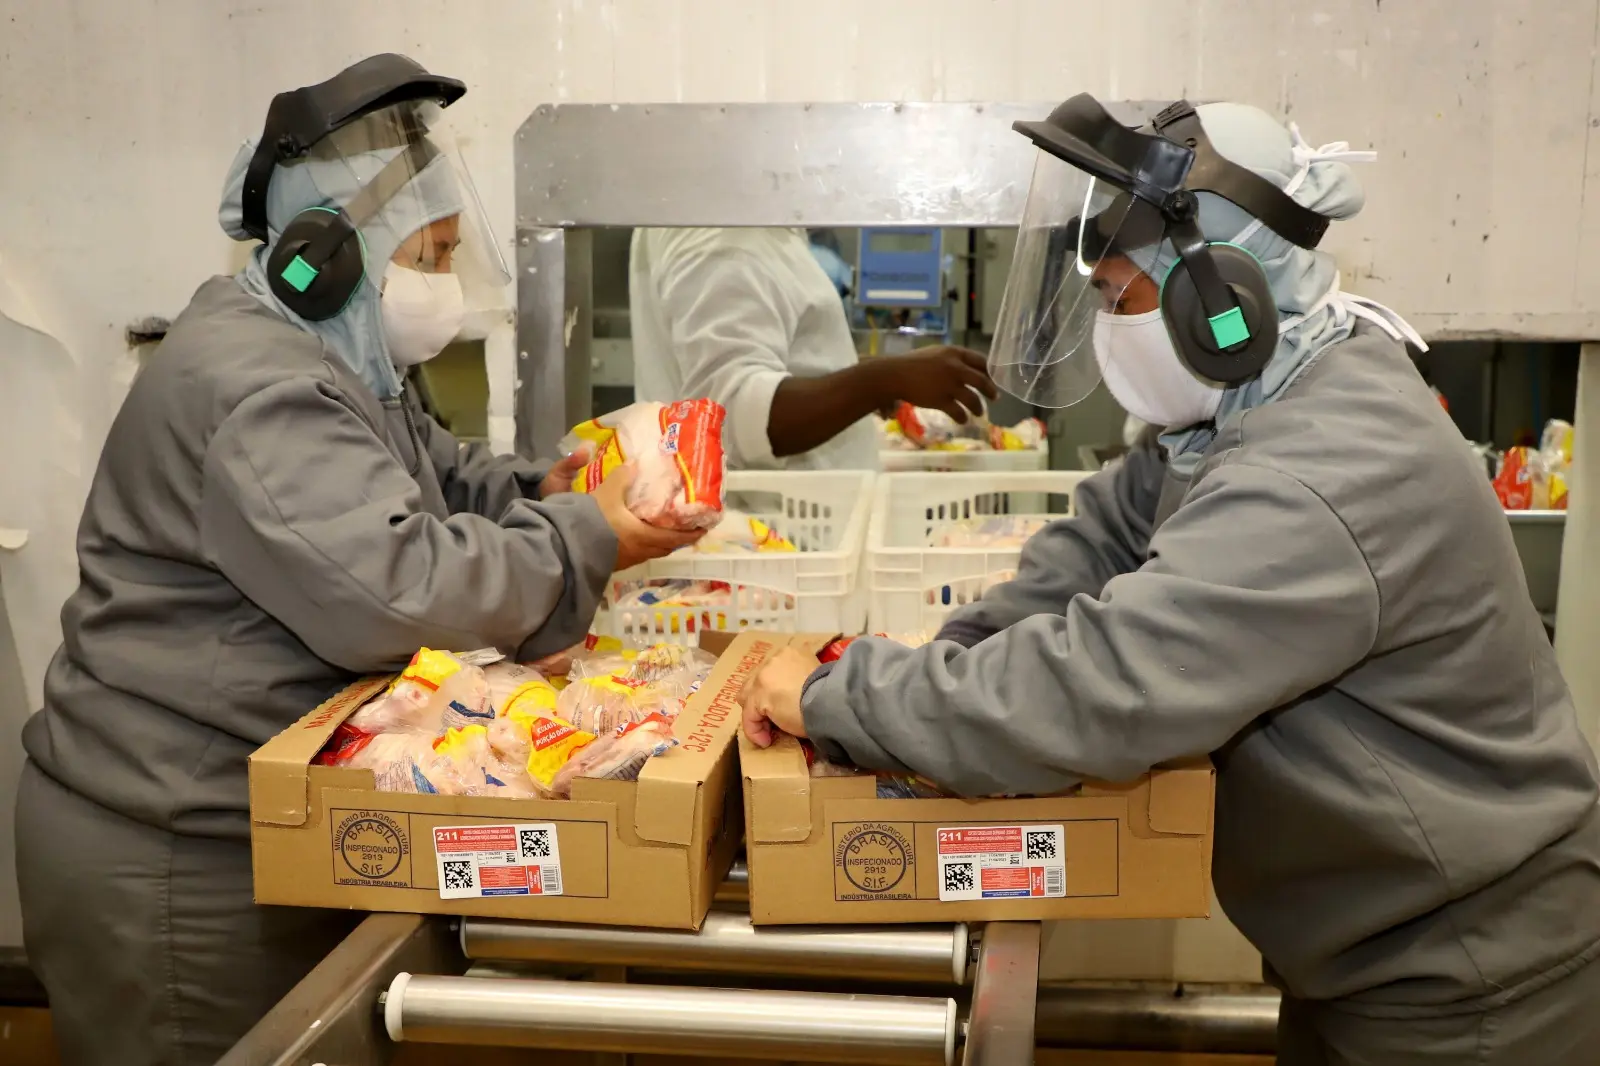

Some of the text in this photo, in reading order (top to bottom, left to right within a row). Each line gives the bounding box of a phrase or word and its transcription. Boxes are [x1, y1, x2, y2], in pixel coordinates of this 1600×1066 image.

[703, 673, 746, 722] CONGELADO
[536, 732, 556, 745] PORÇÃO
[334, 813, 358, 851] MINISTÉRIO
[372, 812, 409, 855] AGRICULTURA
[347, 822, 394, 843] BRASIL
[436, 831, 458, 841] 211
[939, 832, 962, 841] 211
[345, 845, 398, 854] INSPECIONADO
[836, 826, 862, 867] MINISTÉRIO
[876, 823, 914, 865] AGRICULTURA
[849, 834, 898, 855] BRASIL
[847, 858, 902, 866] INSPECIONADO
[360, 863, 385, 875] S.I.F.
[340, 878, 371, 886] INDÚSTRIA
[863, 877, 888, 888] S.I.F.
